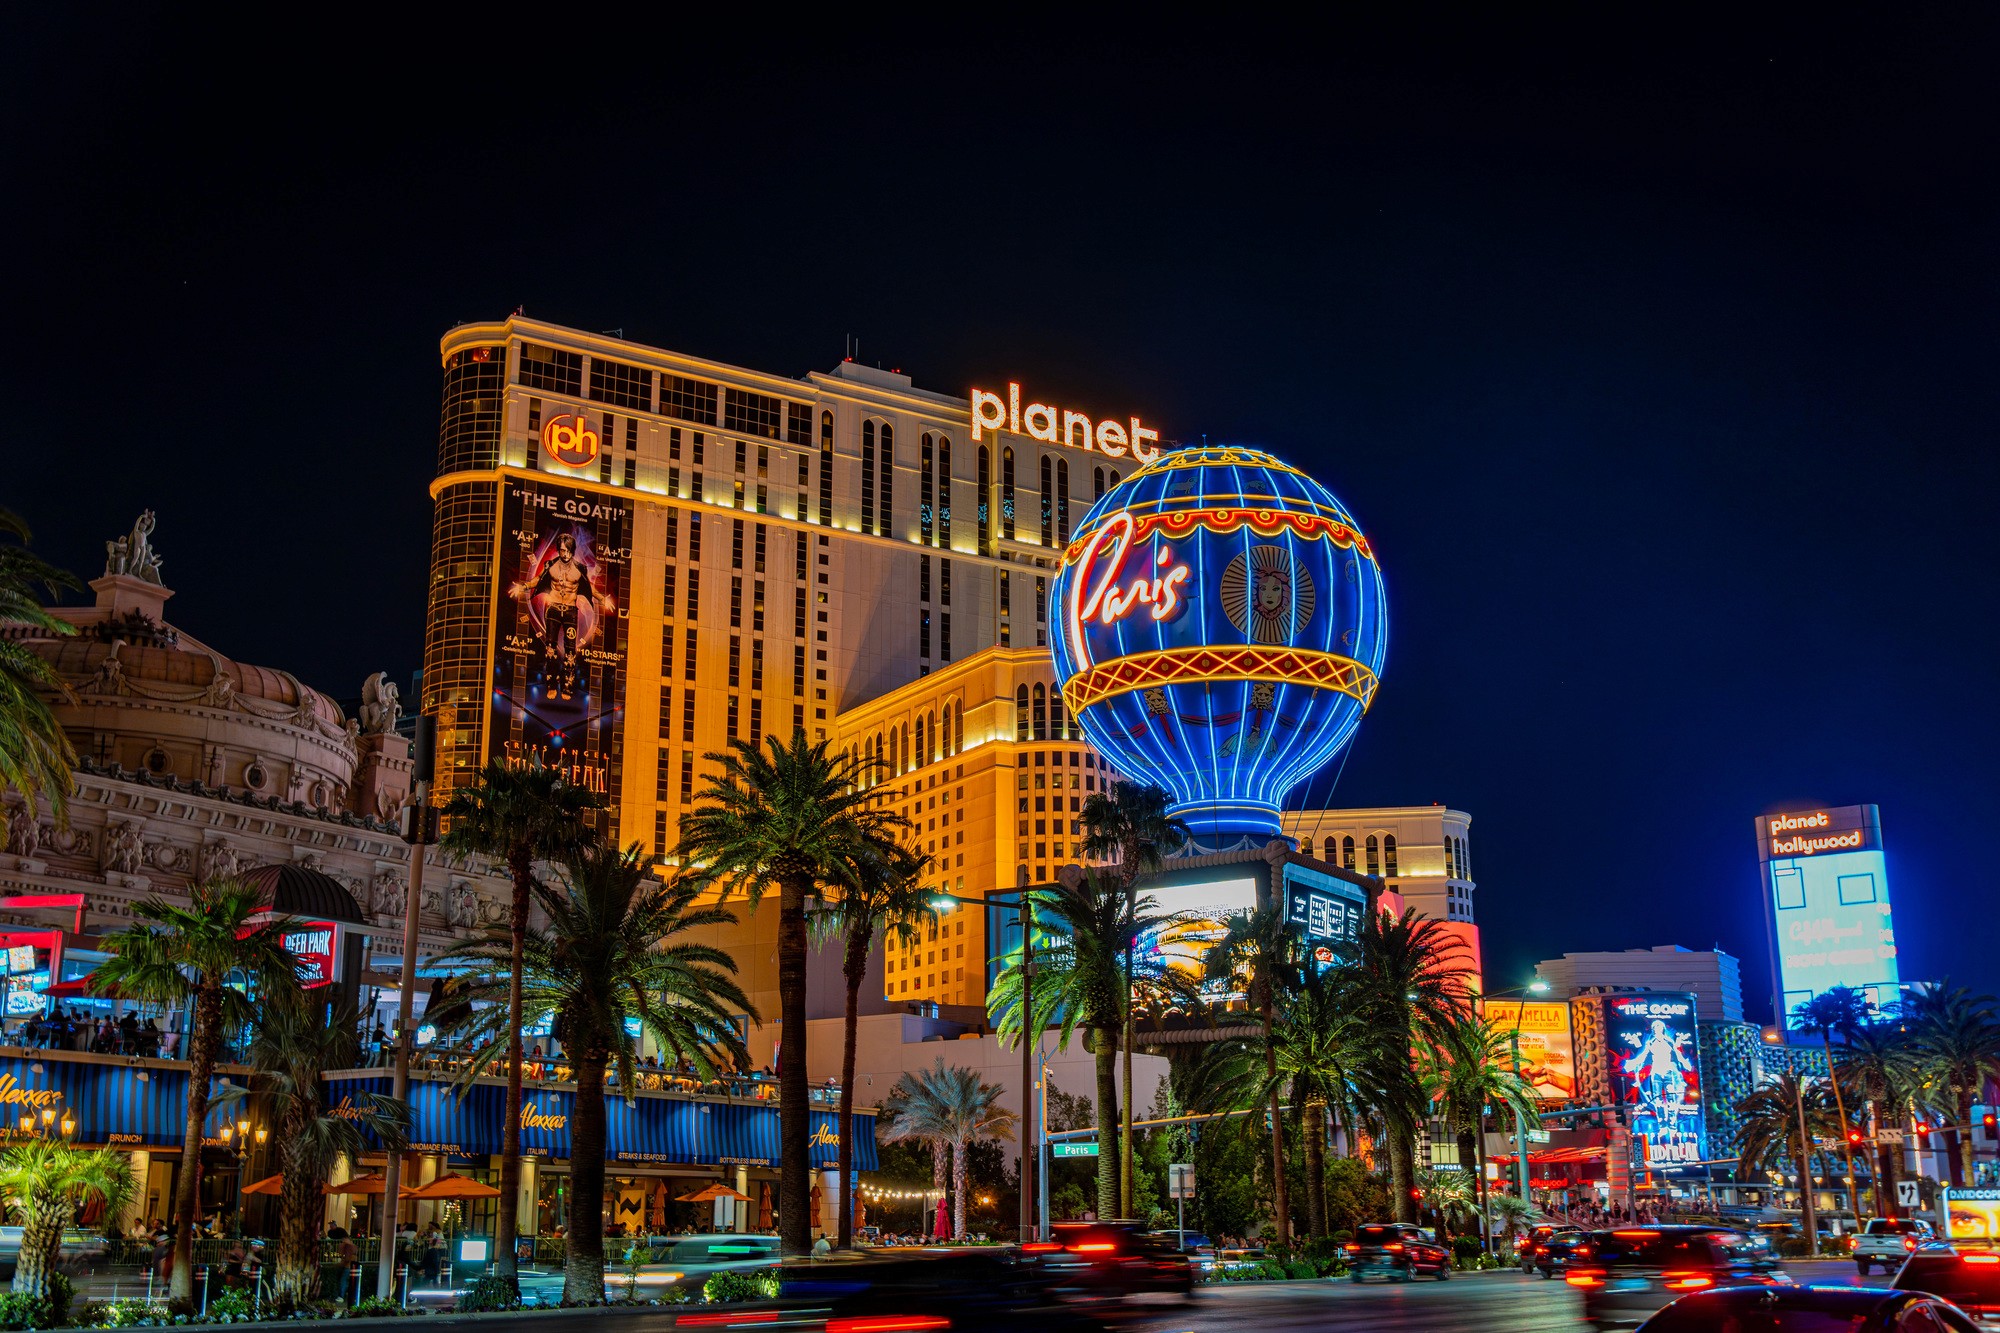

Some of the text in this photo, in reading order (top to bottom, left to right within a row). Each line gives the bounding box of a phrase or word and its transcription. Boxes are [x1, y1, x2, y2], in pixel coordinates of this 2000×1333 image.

[970, 382, 1160, 464] planet
[551, 416, 598, 456] ph
[1072, 511, 1188, 672] Paris
[561, 747, 610, 760] ANGEL
[1771, 812, 1828, 836] planet
[1773, 831, 1860, 855] hollywood
[1190, 909, 1222, 919] PICTURES
[1224, 906, 1252, 916] STUDIS
[308, 930, 331, 956] PARK
[1493, 1010, 1560, 1021] CARAMELLA
[109, 1133, 142, 1143] BRUNCH
[441, 1144, 460, 1152] PASTA
[526, 1147, 548, 1156] ITALIAN
[1065, 1146, 1089, 1155] Paris
[617, 1152, 638, 1161] STEAKS
[643, 1153, 667, 1162] SEAFOOD
[719, 1156, 749, 1165] BOTTOMLESS
